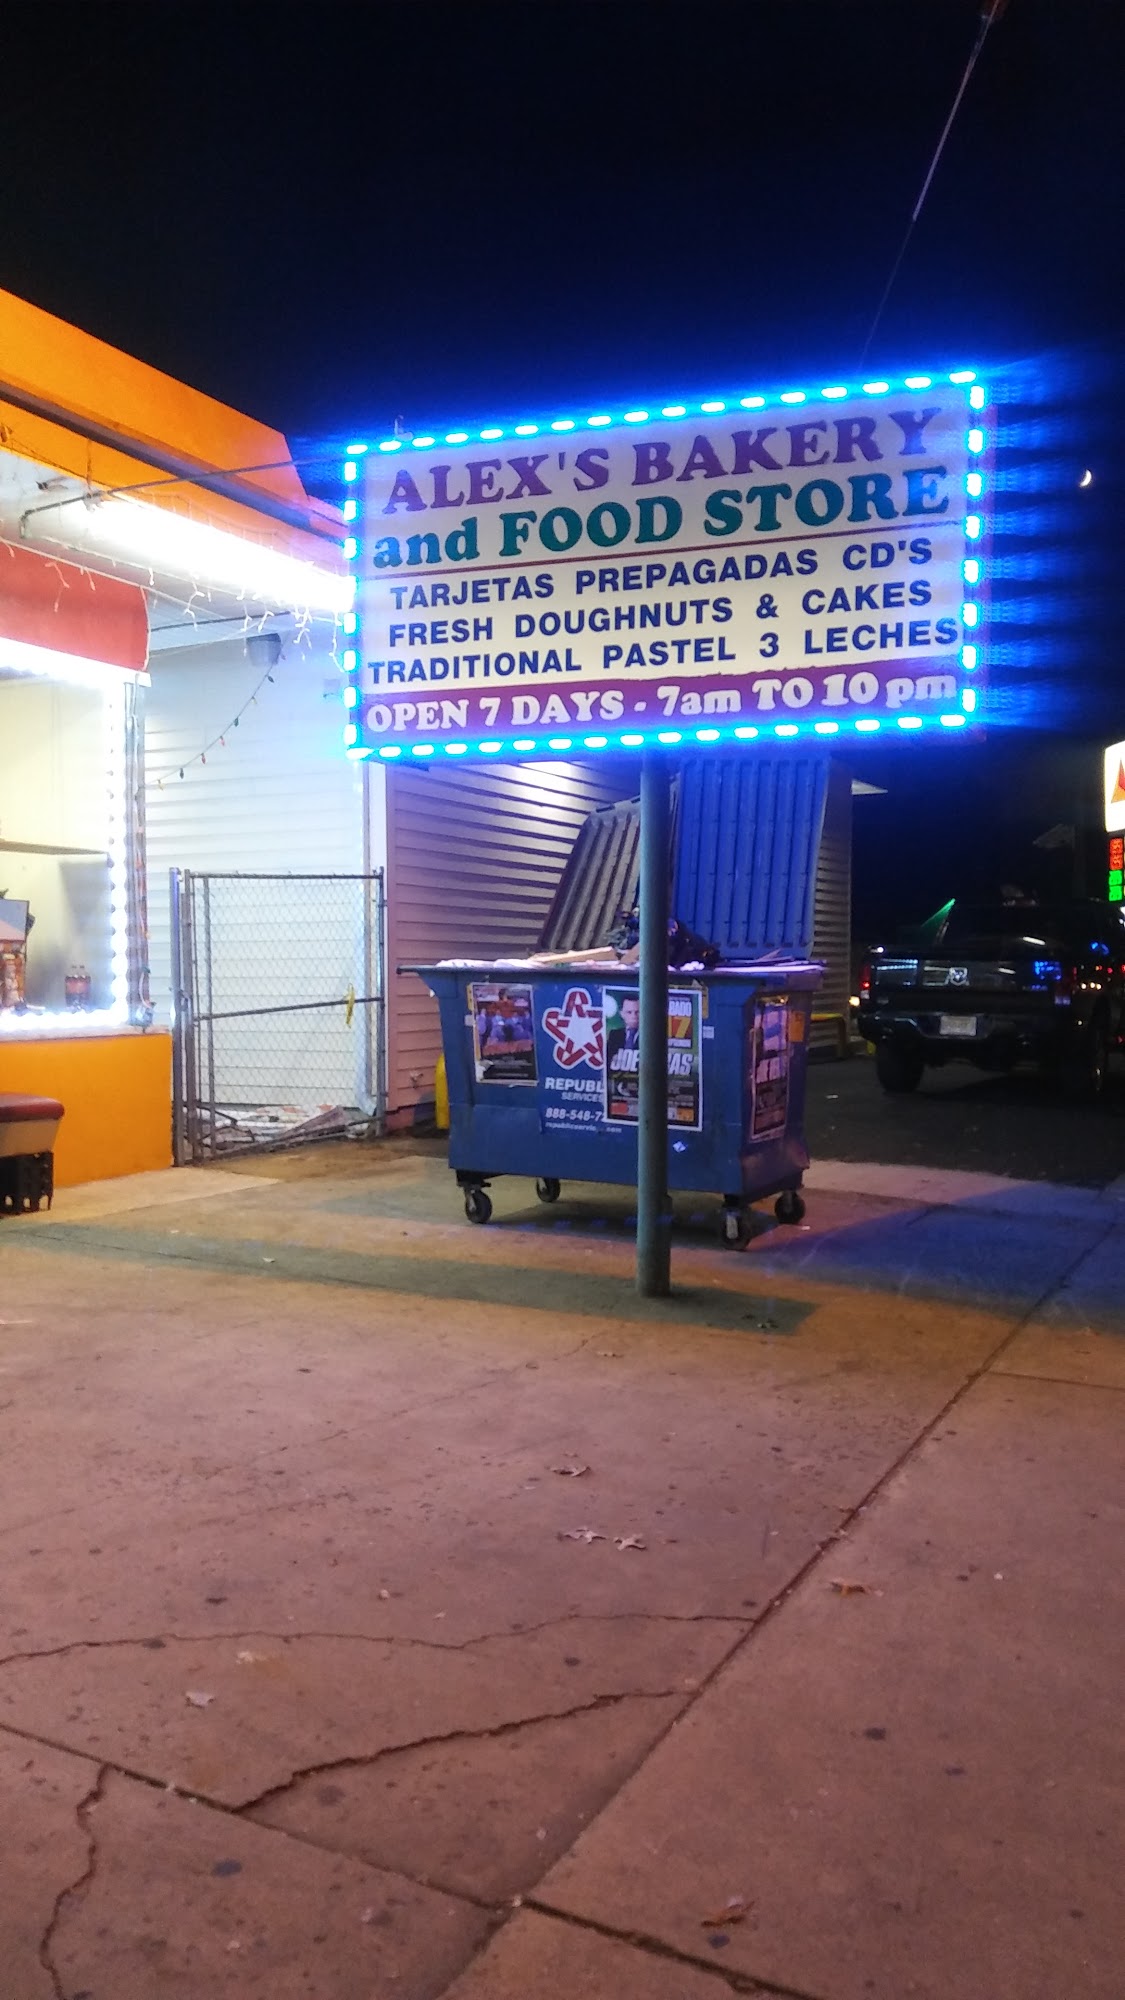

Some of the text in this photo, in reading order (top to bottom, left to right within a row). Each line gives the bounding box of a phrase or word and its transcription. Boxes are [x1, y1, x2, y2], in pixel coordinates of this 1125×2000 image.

[382, 407, 942, 515] ALEX'S BAKERY
[373, 465, 949, 569] and FOOD STORE
[390, 537, 933, 610] TARJETAS PREPAGADAS CD'S
[389, 579, 933, 648] FRESH DOUGHNUTS & CAKES
[367, 617, 959, 685] TRADITIONAL PASTEL 3 LECHES
[366, 699, 469, 733] OPEN
[479, 696, 502, 727] 7
[511, 690, 625, 726] DAYS
[656, 684, 742, 717] 7am
[752, 677, 814, 711] TO
[820, 671, 880, 707] 10
[885, 675, 957, 709] pm
[545, 1077, 604, 1093] REPUBL
[545, 1107, 606, 1121] 888-548-7
